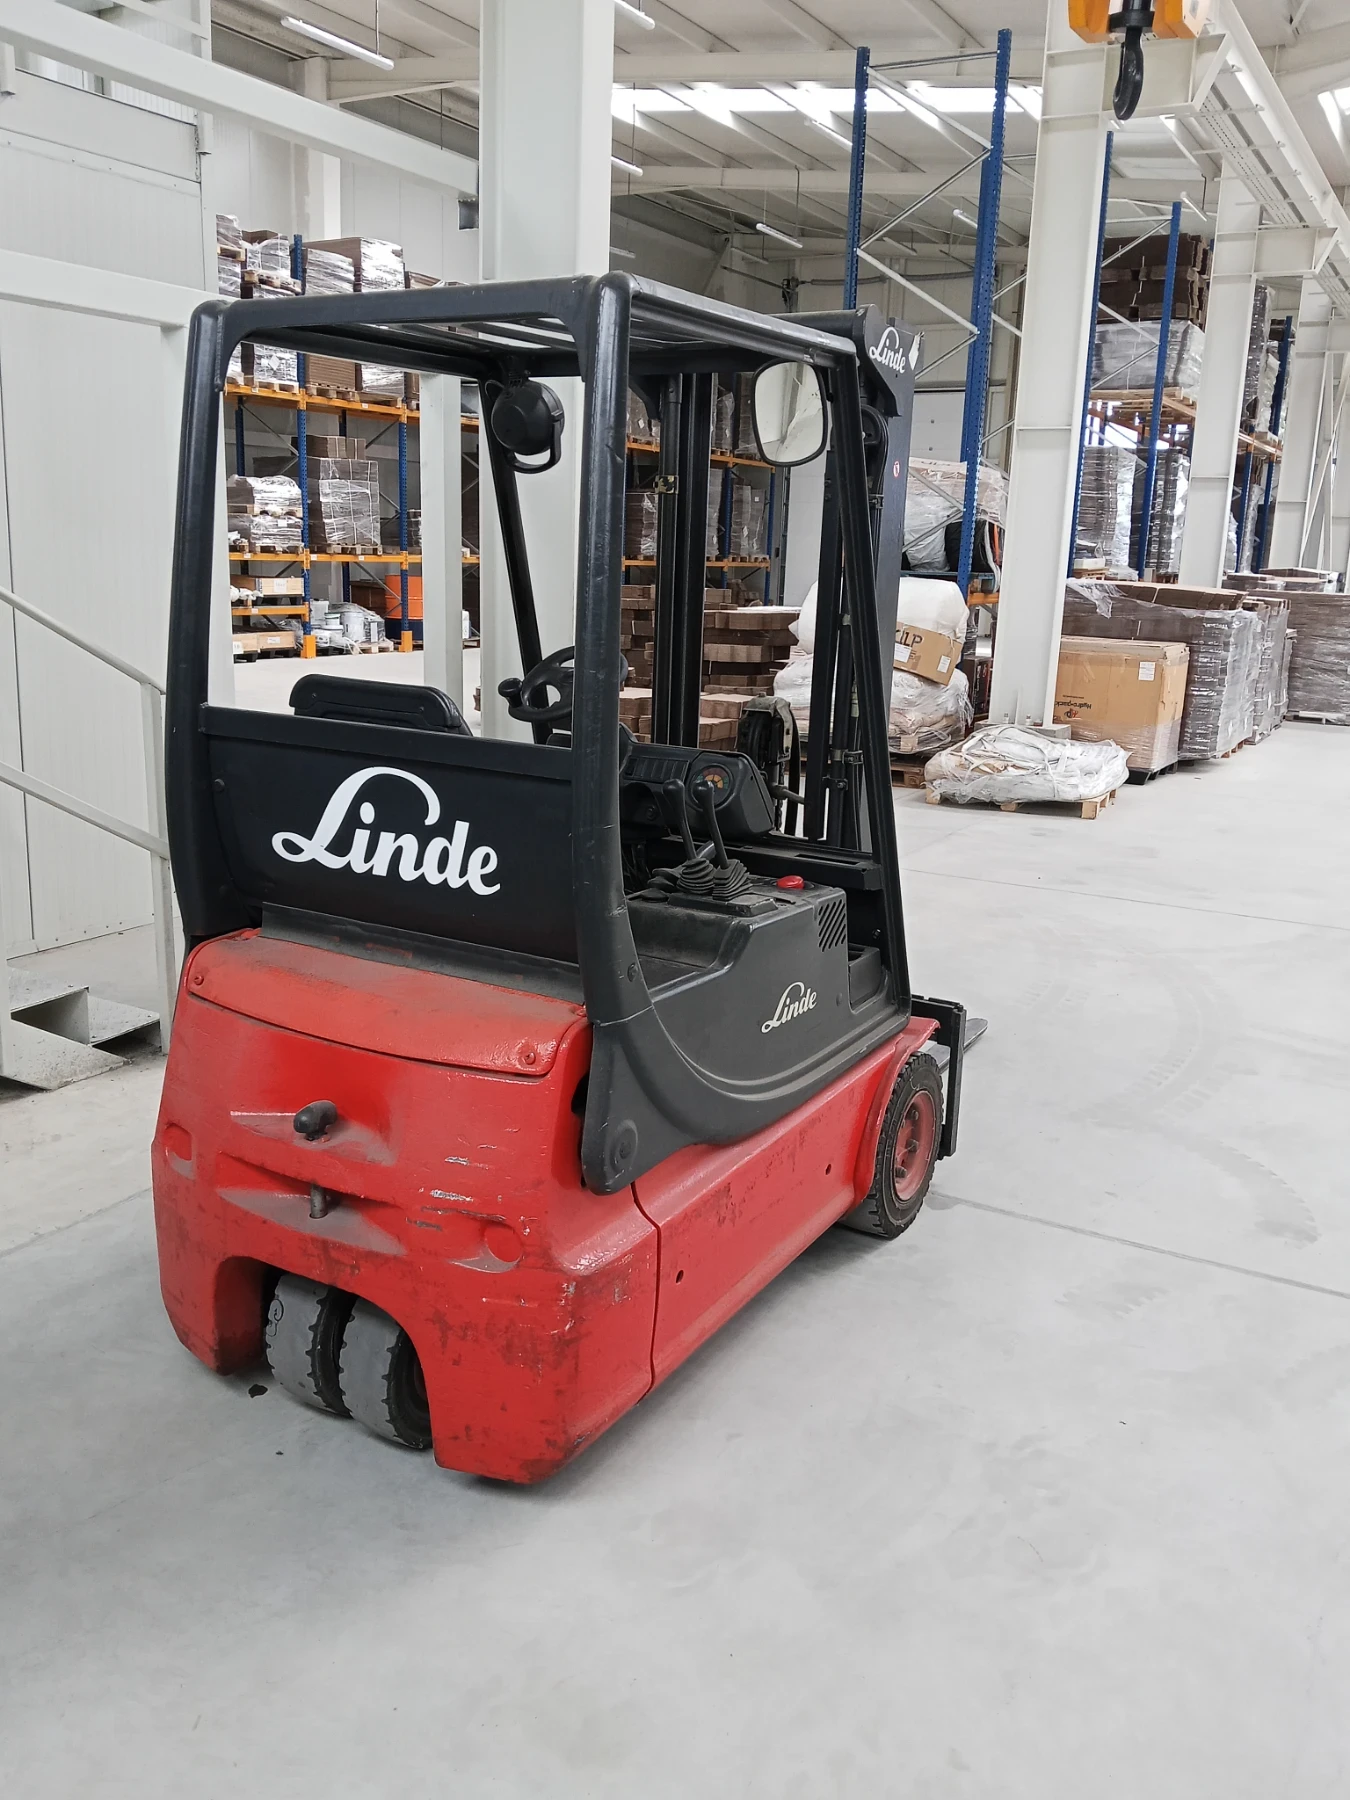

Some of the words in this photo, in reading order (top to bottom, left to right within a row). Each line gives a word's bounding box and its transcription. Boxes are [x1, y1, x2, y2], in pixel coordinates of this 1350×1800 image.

[869, 326, 906, 373] Linde
[271, 766, 501, 896] Linde
[761, 981, 817, 1033] Linde
